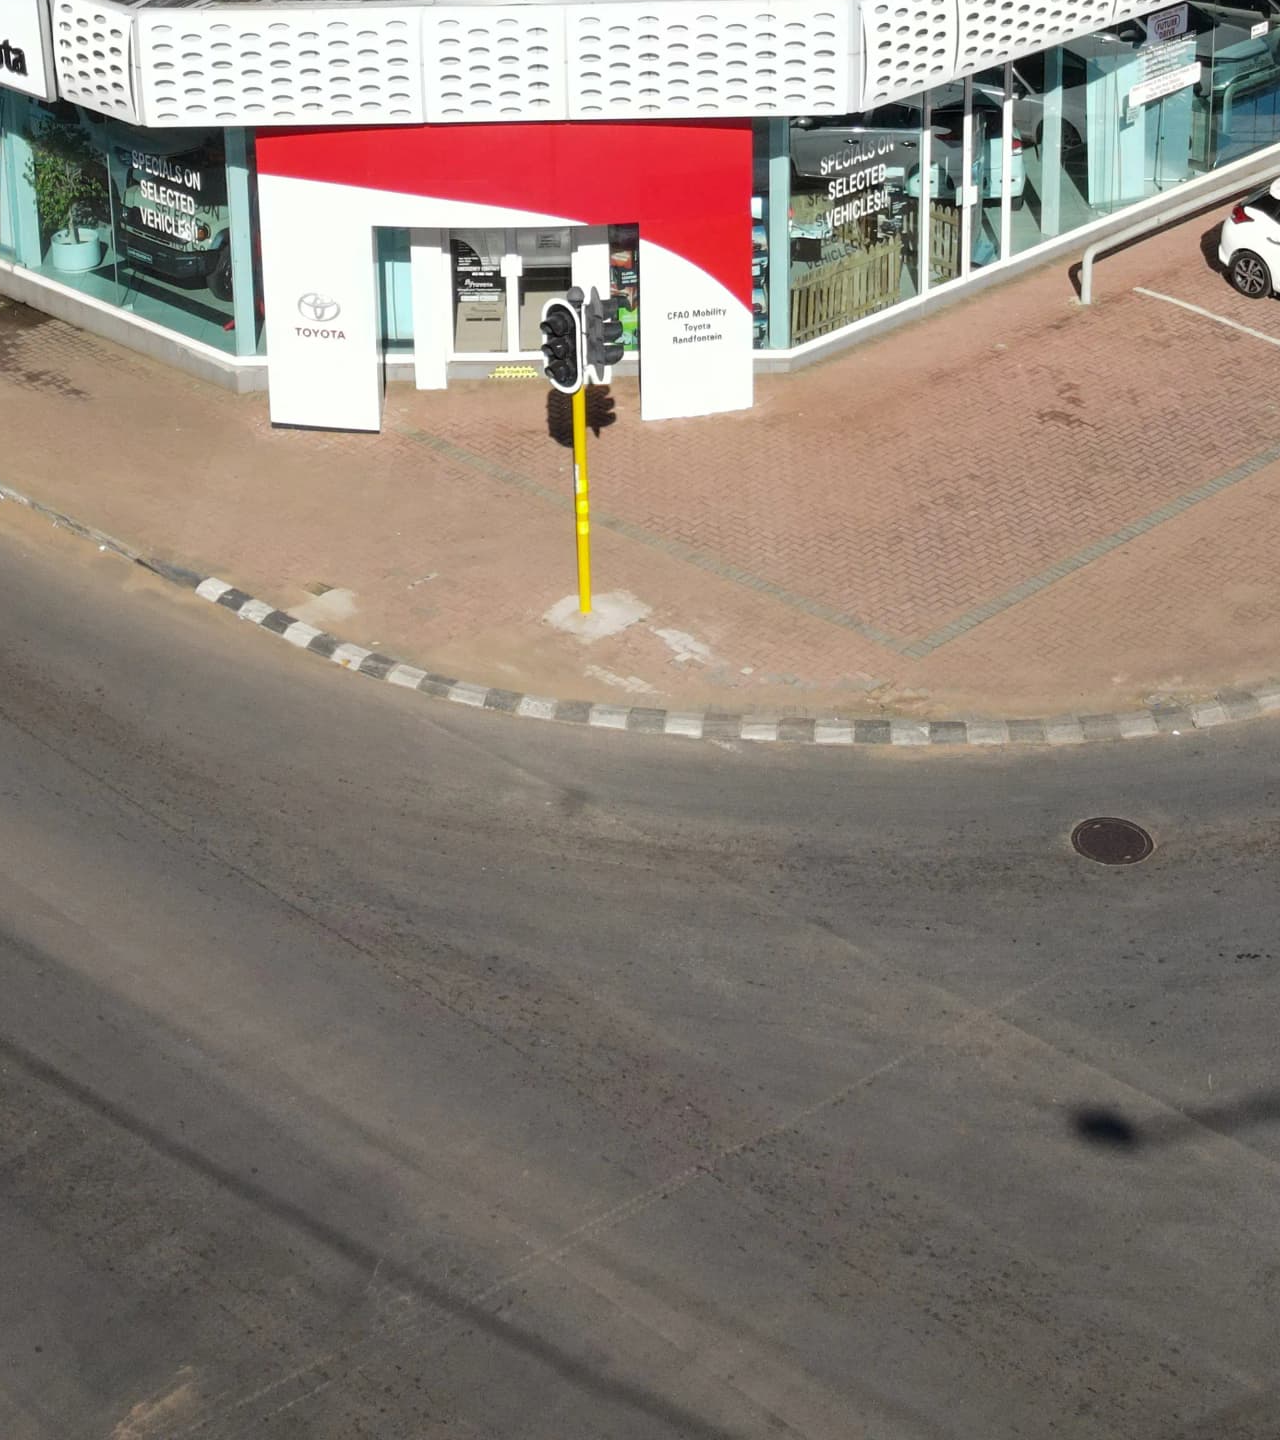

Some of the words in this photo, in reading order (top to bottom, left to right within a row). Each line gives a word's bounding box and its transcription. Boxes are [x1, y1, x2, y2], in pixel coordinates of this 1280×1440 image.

[820, 140, 876, 175] SPECIALS
[877, 134, 895, 155] ON
[131, 150, 183, 185] SPECIALS
[184, 168, 201, 191] ON
[828, 163, 887, 200] SELECTED
[140, 179, 196, 216] SELECTED
[667, 310, 690, 320] CFAO
[692, 307, 727, 318] Mobility
[294, 327, 346, 340] TOYOTA
[672, 333, 722, 345] Randfontein
[683, 323, 711, 333] Toyota
